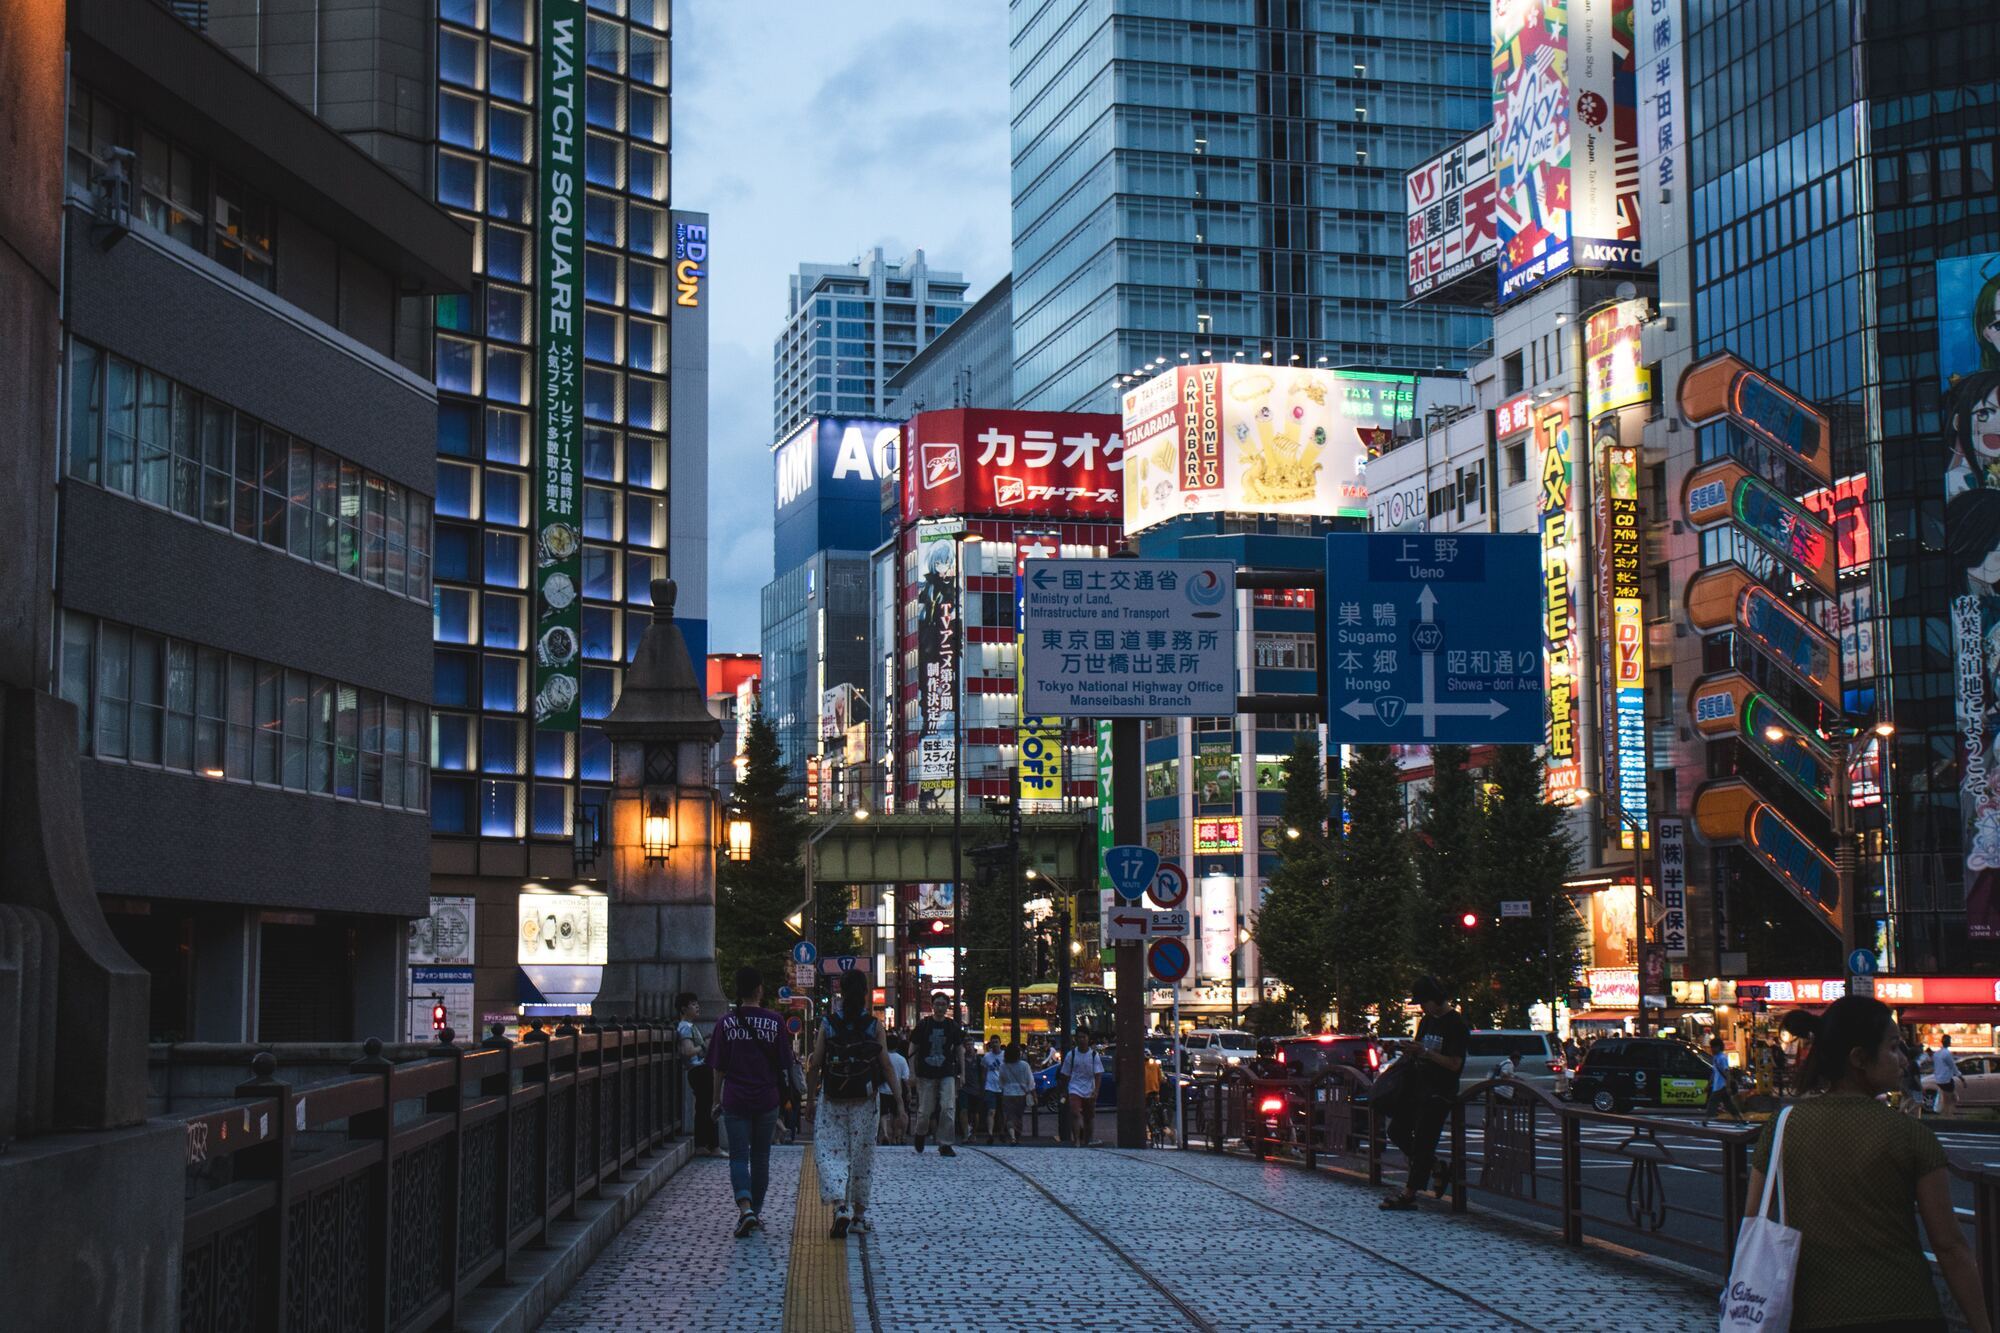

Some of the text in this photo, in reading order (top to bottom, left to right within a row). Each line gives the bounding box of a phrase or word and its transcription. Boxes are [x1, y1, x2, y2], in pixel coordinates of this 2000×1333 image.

[1585, 56, 1593, 78] Shop
[1533, 131, 1553, 158] ONE
[549, 18, 574, 336] WATCH SQUARE
[1408, 197, 1461, 246] 秋葉原
[1408, 240, 1461, 285] ホビー
[1583, 244, 1628, 262] AKKY
[677, 224, 706, 306] EDION
[1343, 388, 1413, 403] TAX FREE
[547, 340, 560, 513] 人気ブランド多数取り揃え
[1498, 399, 1528, 434] 免税
[560, 345, 573, 515] メンズ・レディース腕時計
[1126, 413, 1176, 446] TAKARADA
[1186, 378, 1200, 487] AKIHABARA
[1202, 370, 1217, 486] WELCOME TO
[977, 428, 1124, 471] カラオケ
[777, 429, 812, 511] AOKI
[1543, 411, 1565, 510] TAX
[1613, 501, 1636, 512] ゲーム
[1690, 481, 1727, 513] SEGA
[1377, 486, 1425, 531] FIORE
[1616, 515, 1634, 526] CD
[1613, 529, 1637, 541] アイドル
[1396, 538, 1458, 562] 上野
[1613, 543, 1638, 554] アニメ
[1410, 566, 1444, 579] Ueno
[1614, 557, 1637, 569] コミック
[1063, 570, 1178, 591] 国土交通省
[1616, 572, 1637, 583] ホビー
[1031, 593, 1069, 605] Ministry
[1074, 593, 1084, 605] of
[1031, 607, 1170, 621] Infrastructure and Transport
[1338, 602, 1397, 626] 巣鴨
[1042, 630, 1218, 650] 東京国道事務所
[1338, 631, 1397, 645] Sugamo
[1416, 631, 1438, 645] 437
[1338, 650, 1397, 673] 本郷
[1447, 651, 1535, 674] 昭和通り
[1619, 624, 1640, 681] DVD
[1061, 654, 1199, 674] 万世橋出張所
[1038, 680, 1223, 694] Tokyo National Highway Office
[1345, 678, 1391, 692] Hongo
[1447, 678, 1541, 690] Showa-dori Ave.
[1070, 694, 1191, 706] Manseibashi Branch
[1381, 701, 1398, 718] 17
[1697, 692, 1735, 722] SEGA
[1958, 596, 1988, 804] 秋葉原泊地にようこそ。
[1550, 769, 1577, 788] AKKY
[1661, 826, 1682, 838] 8F
[1121, 860, 1144, 880] 17
[1877, 984, 1912, 998] 2号館
[757, 1029, 778, 1044] DAY
[1729, 1304, 1764, 1324] WORLD
